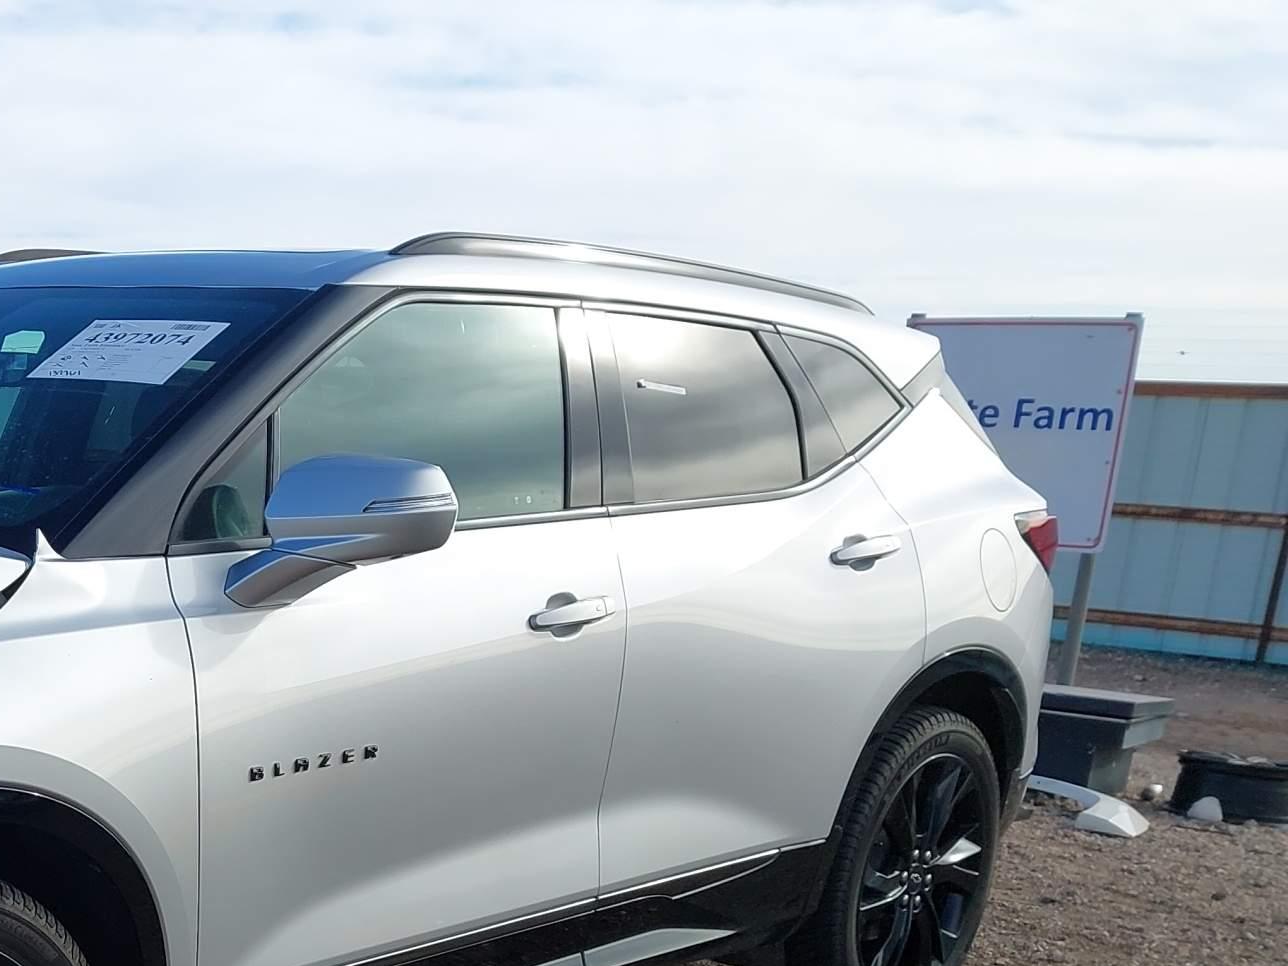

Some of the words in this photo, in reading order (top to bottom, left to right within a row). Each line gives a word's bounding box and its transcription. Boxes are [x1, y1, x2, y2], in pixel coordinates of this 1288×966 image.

[85, 331, 196, 346] 43972074
[1013, 398, 1114, 431] Farm
[248, 744, 380, 782] BLAZER
